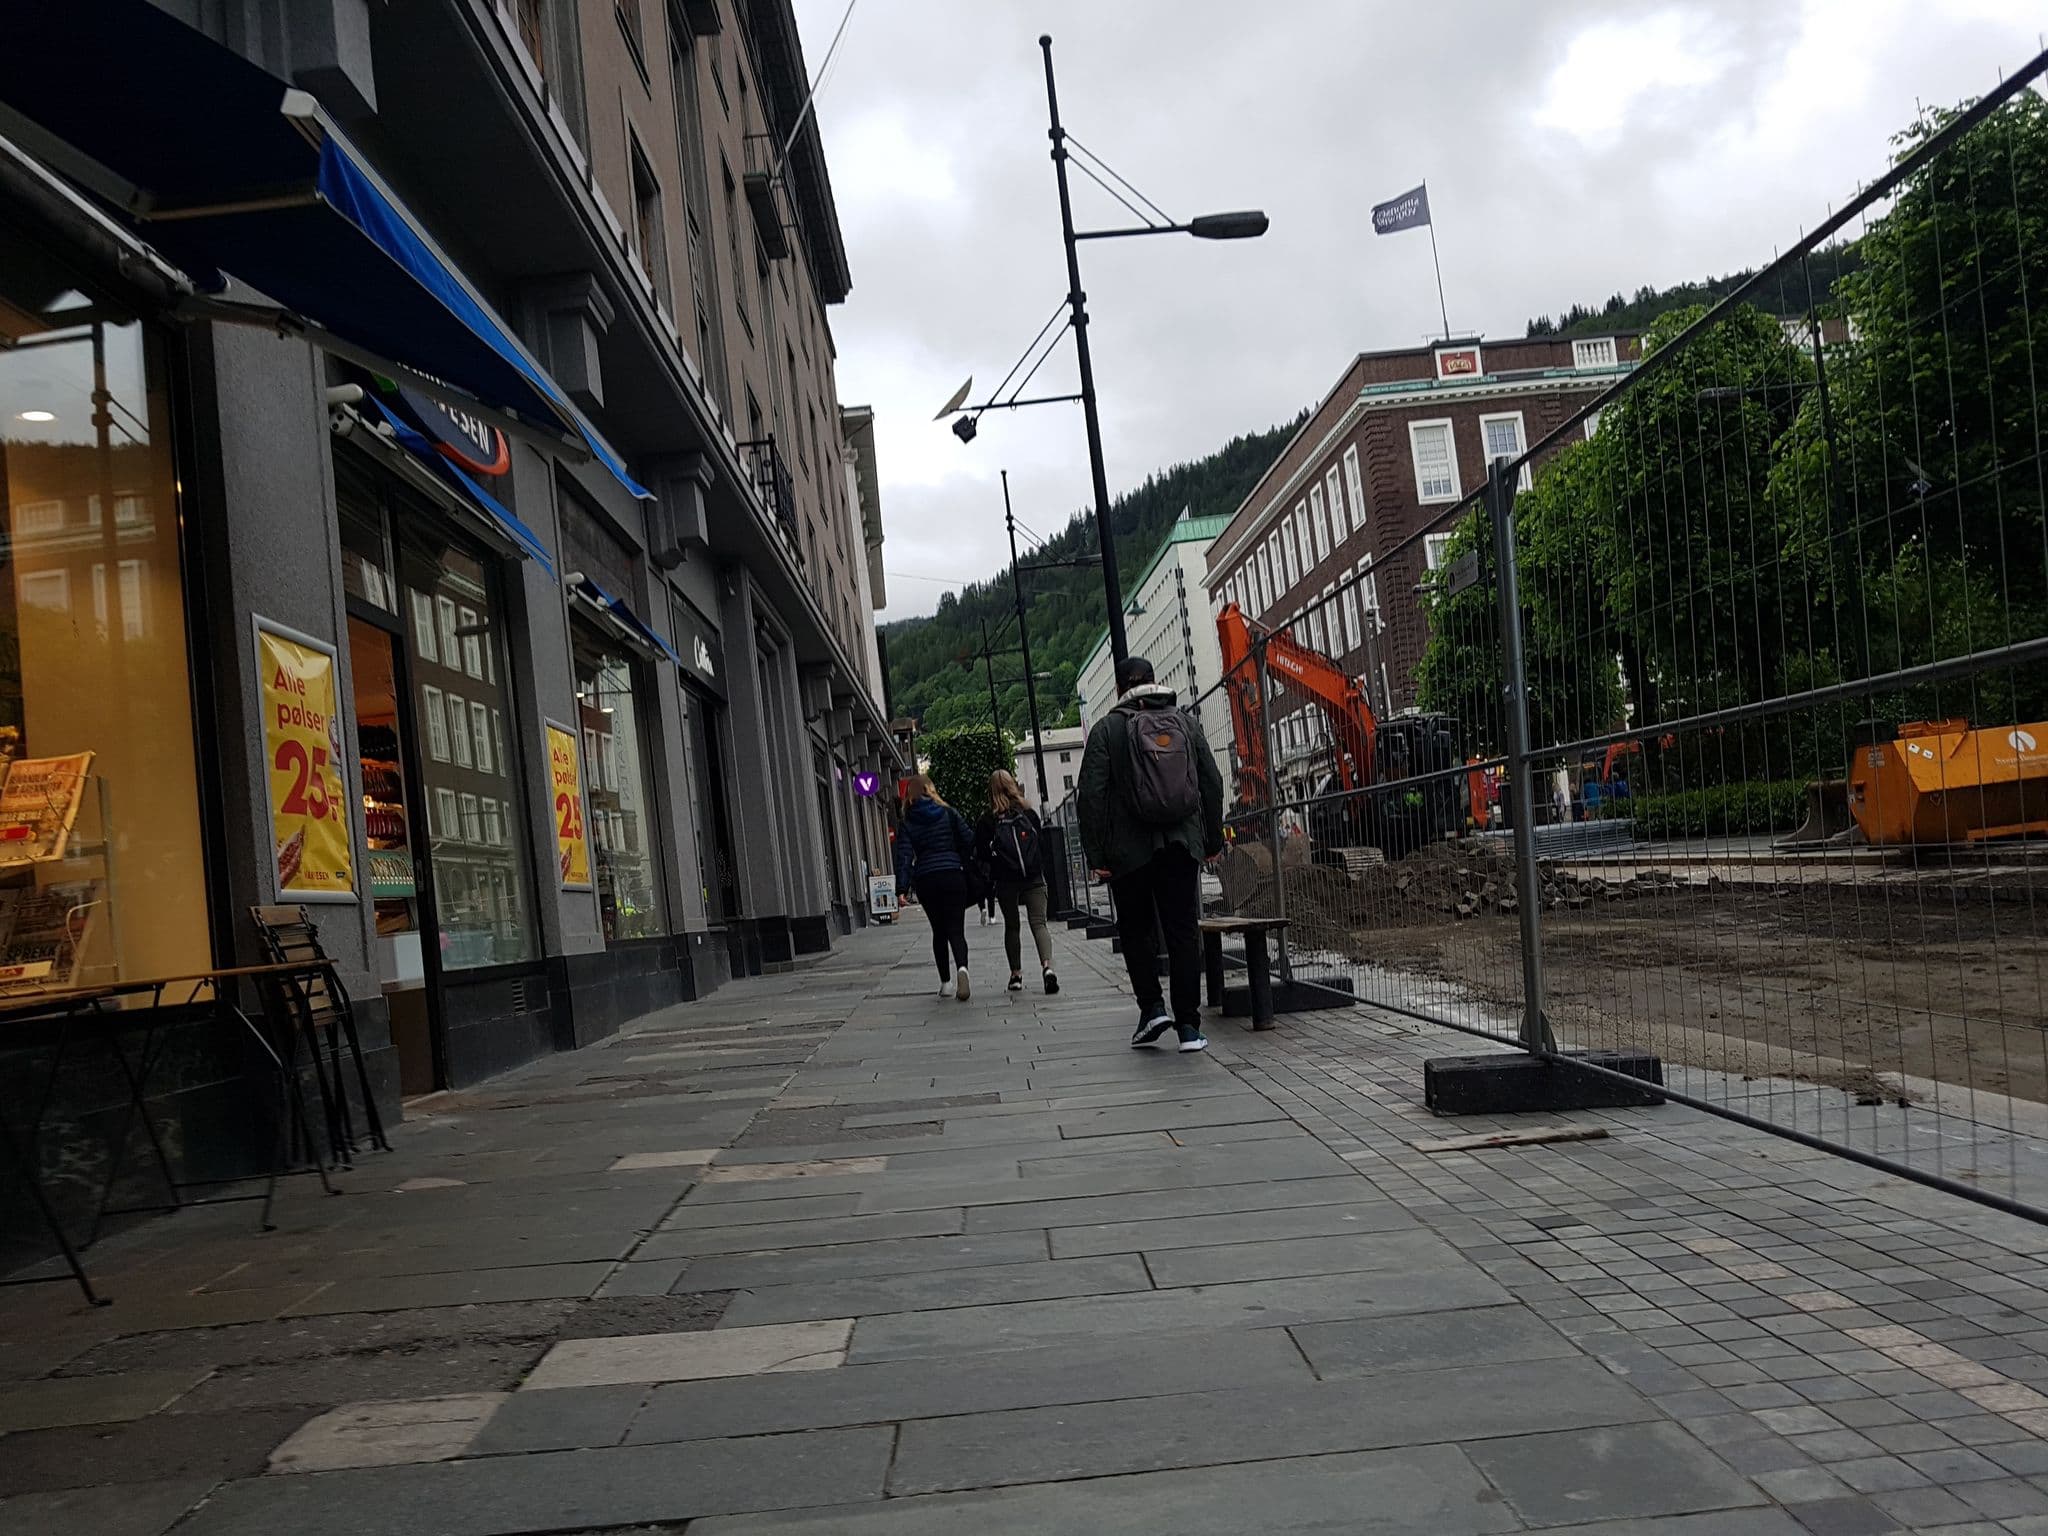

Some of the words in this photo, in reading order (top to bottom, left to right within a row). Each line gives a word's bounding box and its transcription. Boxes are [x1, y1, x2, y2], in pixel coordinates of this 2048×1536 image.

[273, 666, 305, 696] Alle
[277, 699, 325, 732] pølser
[553, 748, 569, 765] Alle
